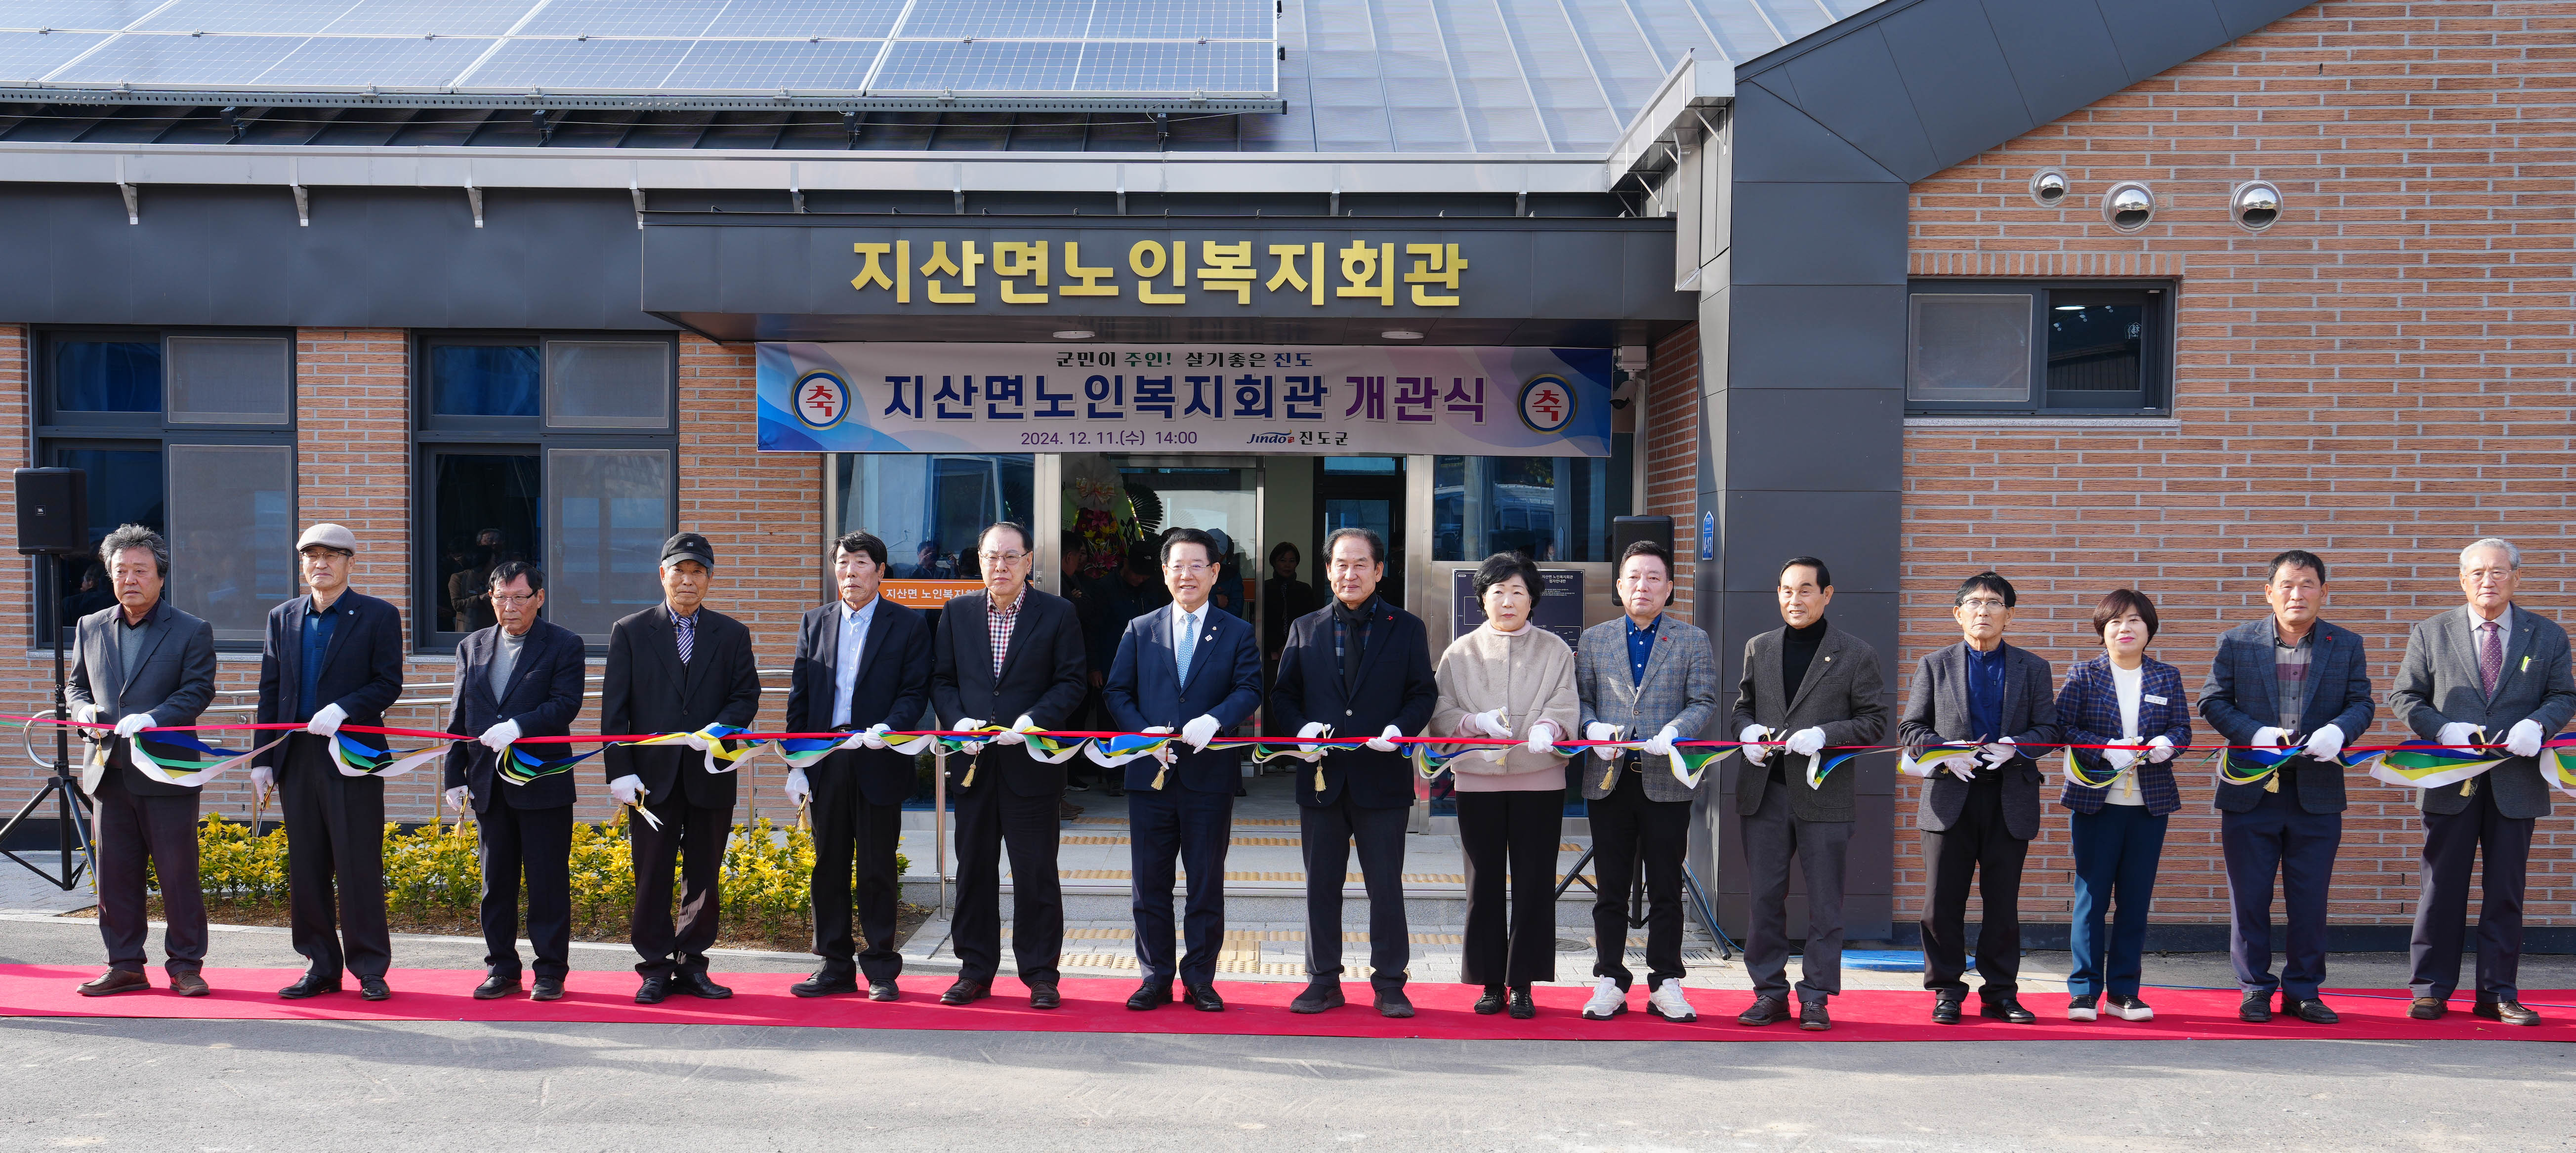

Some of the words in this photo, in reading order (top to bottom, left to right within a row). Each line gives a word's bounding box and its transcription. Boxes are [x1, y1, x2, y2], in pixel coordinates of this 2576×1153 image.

[850, 240, 1468, 306] 지산면노인복지회관
[1056, 352, 1115, 367] 군민이
[1124, 352, 1171, 367] 주인!
[1185, 352, 1266, 368] 살기좋은
[1273, 352, 1313, 368] 진도
[806, 385, 835, 417] 축
[884, 374, 1328, 419] 지산면노인복지회관
[1345, 376, 1484, 422] 개관식
[1532, 390, 1562, 421] 축
[1021, 432, 1063, 445] 2024.
[1069, 432, 1091, 445] 12.
[1155, 431, 1198, 444] 14:00
[1246, 433, 1287, 444] Jindo
[1299, 431, 1348, 446] 진도군
[1703, 536, 1712, 554] 4-13
[886, 588, 917, 599] 지산면
[921, 588, 980, 600] 노인복지
